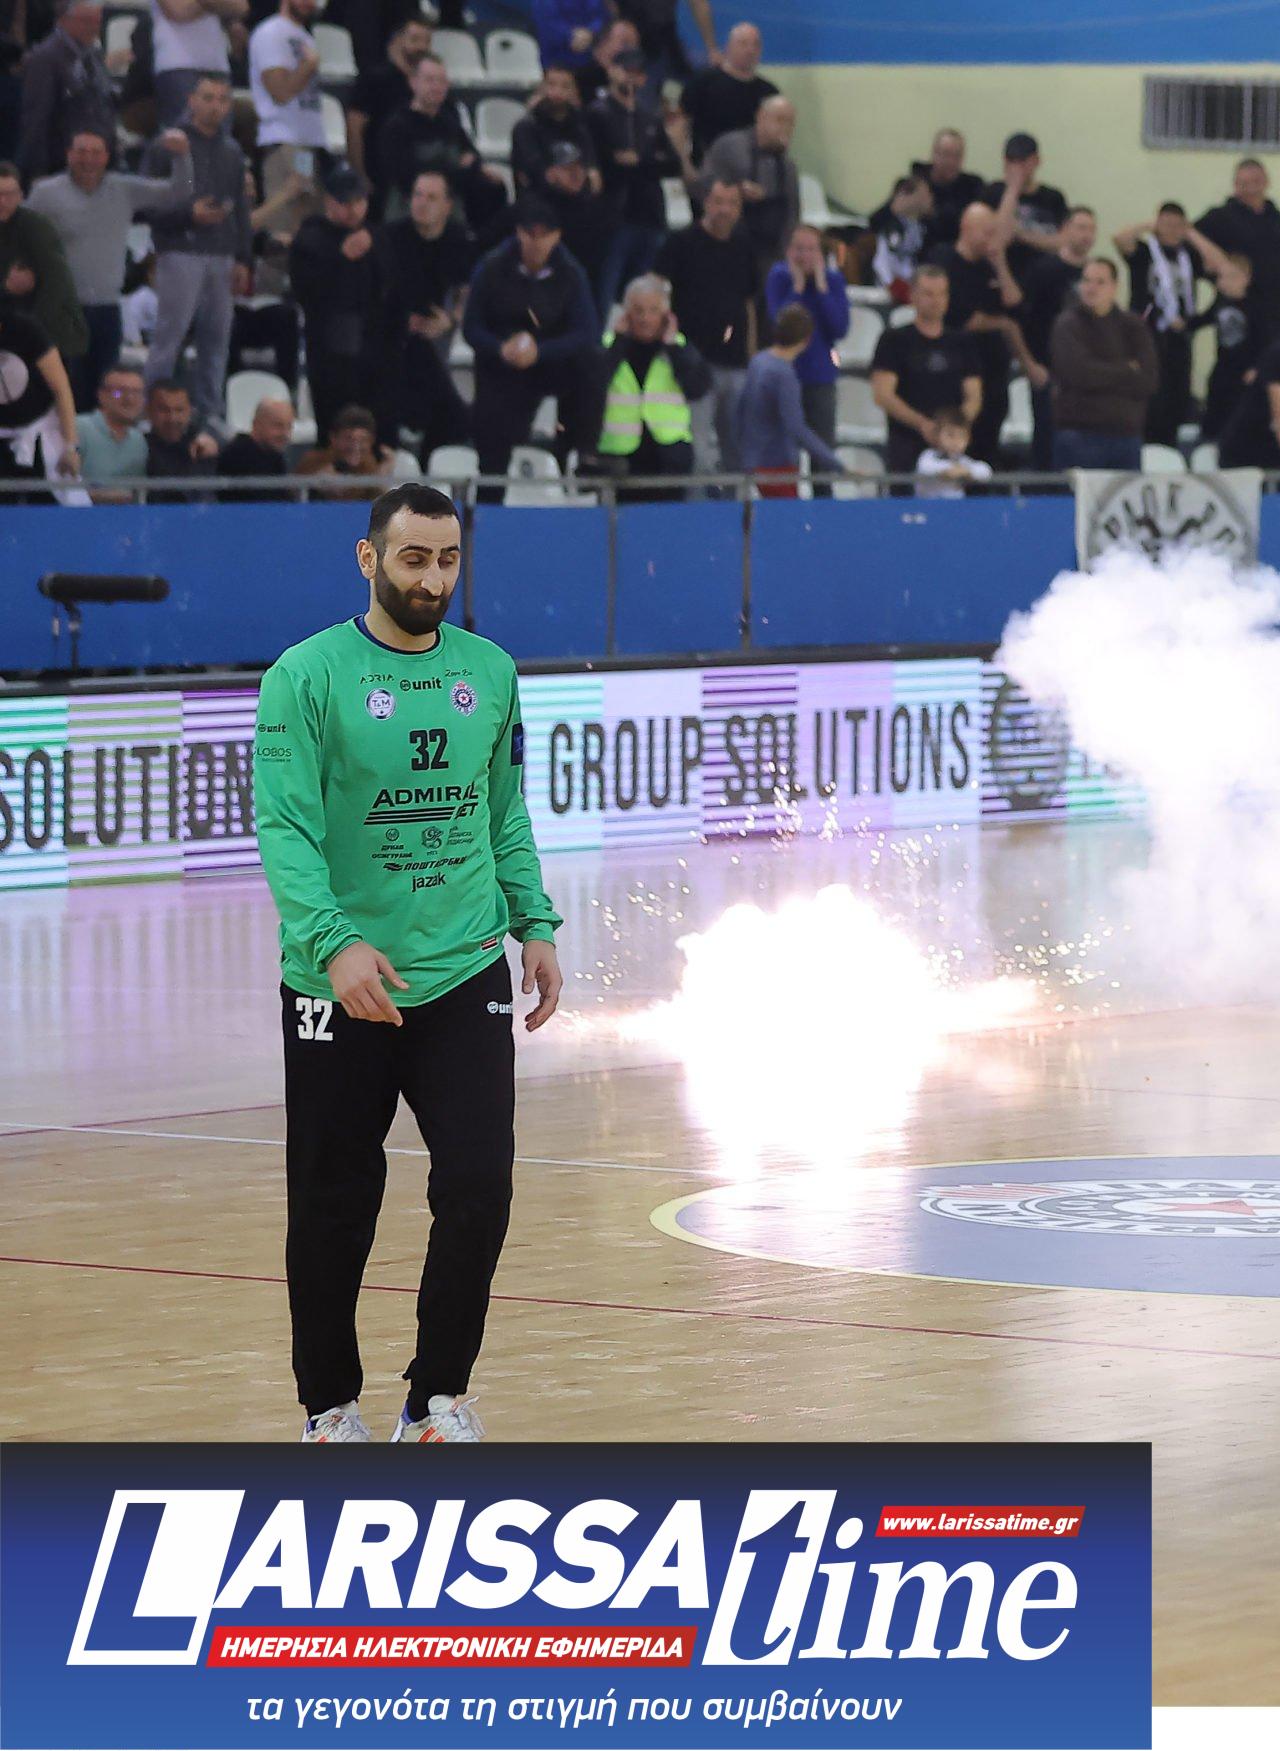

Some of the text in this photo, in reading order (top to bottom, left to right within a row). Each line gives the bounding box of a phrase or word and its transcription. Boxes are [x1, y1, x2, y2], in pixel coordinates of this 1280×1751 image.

[412, 677, 442, 691] unit
[267, 722, 287, 733] unit
[253, 747, 293, 757] LOBOS
[409, 728, 450, 772] 32
[551, 700, 971, 814] GROUP SOLUTIONS
[0, 742, 256, 849] OLUTION
[411, 872, 447, 893] jazak
[295, 996, 334, 1041] 32
